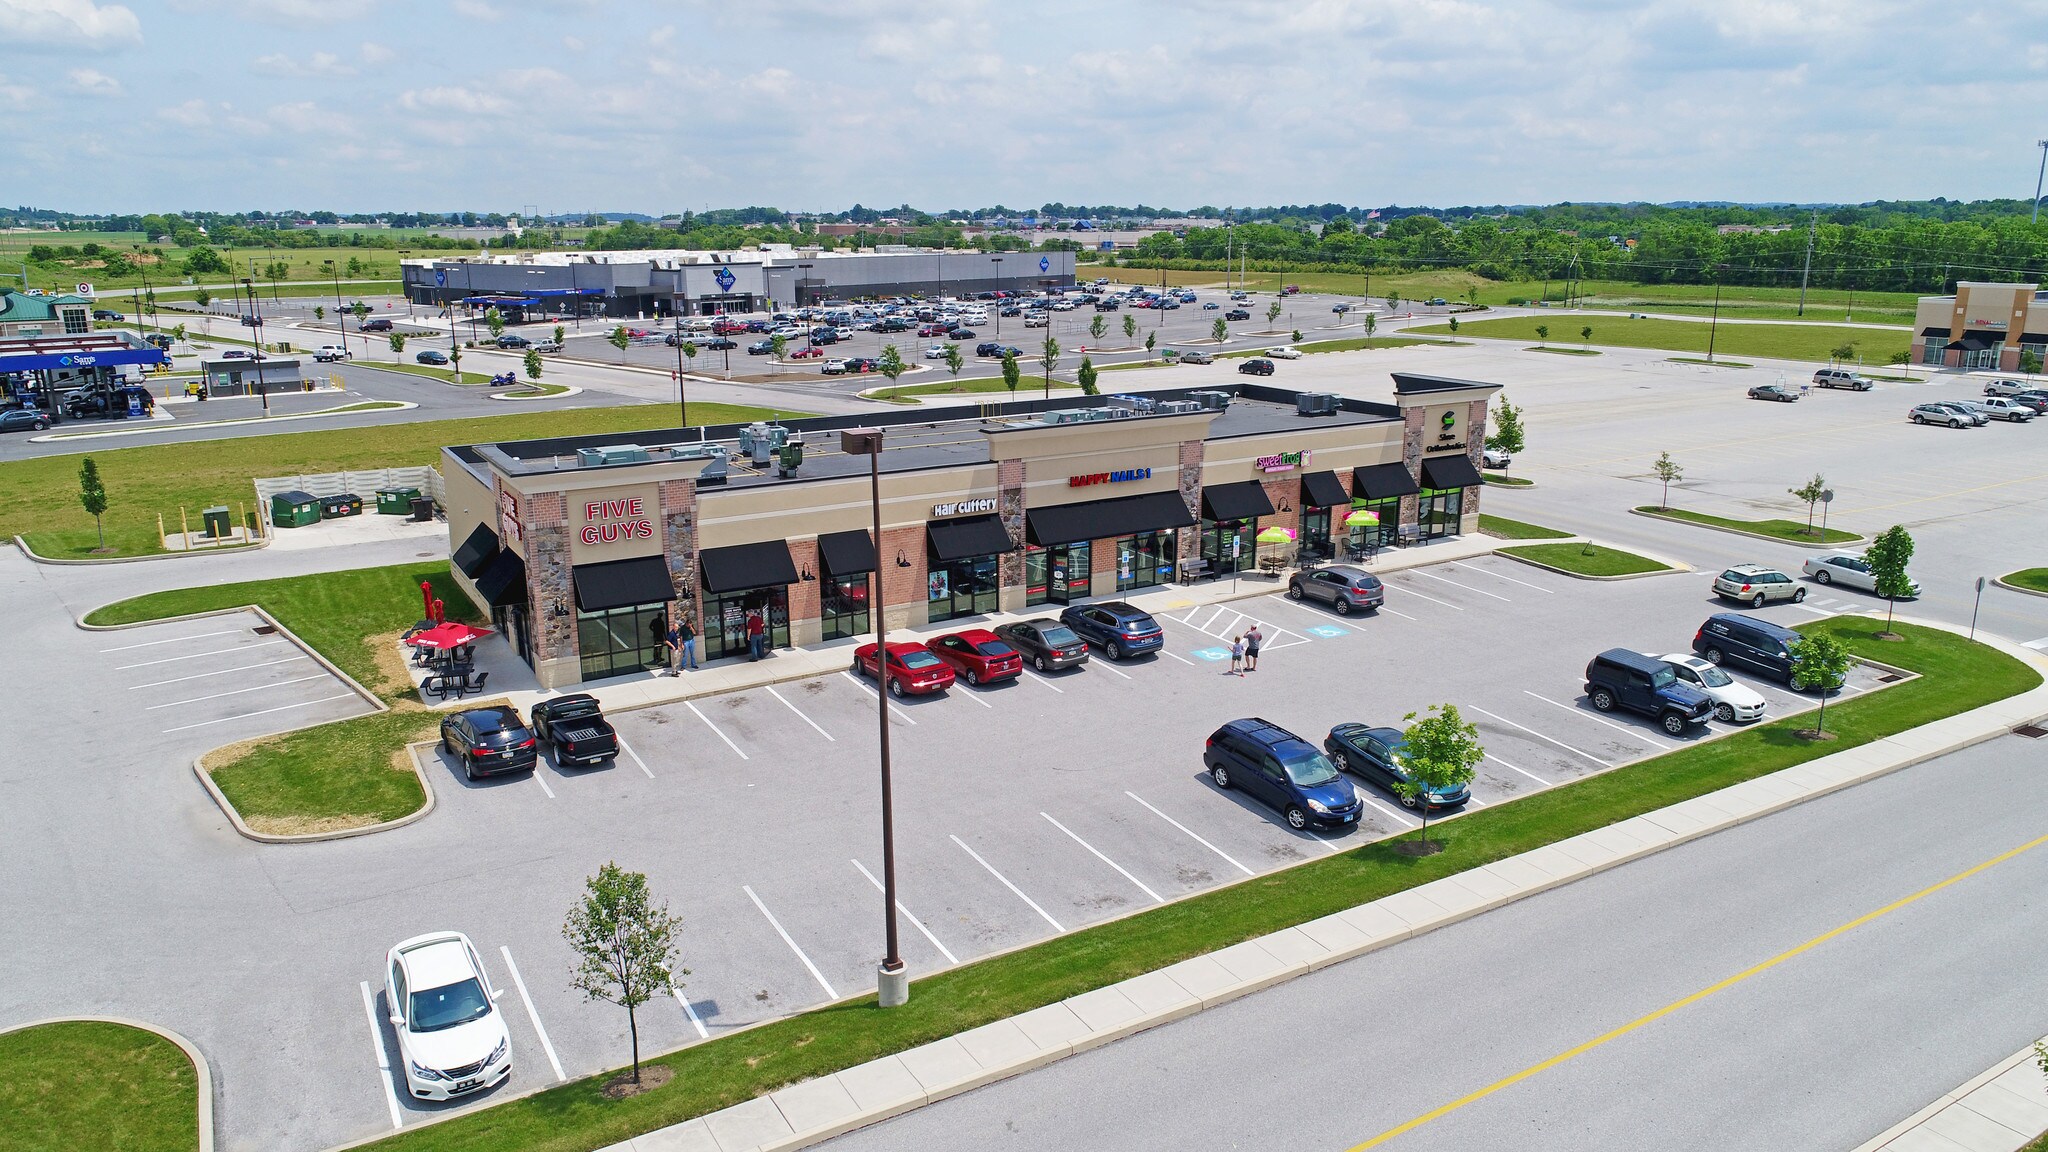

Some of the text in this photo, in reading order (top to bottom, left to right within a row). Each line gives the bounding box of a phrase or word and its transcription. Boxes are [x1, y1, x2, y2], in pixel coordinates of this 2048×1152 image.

[73, 355, 96, 364] Sam's
[1069, 472, 1110, 488] HAPPY
[1110, 468, 1145, 483] NAILS
[585, 497, 644, 522] FIVE
[934, 503, 957, 517] Hair
[580, 519, 654, 545] GUYS
